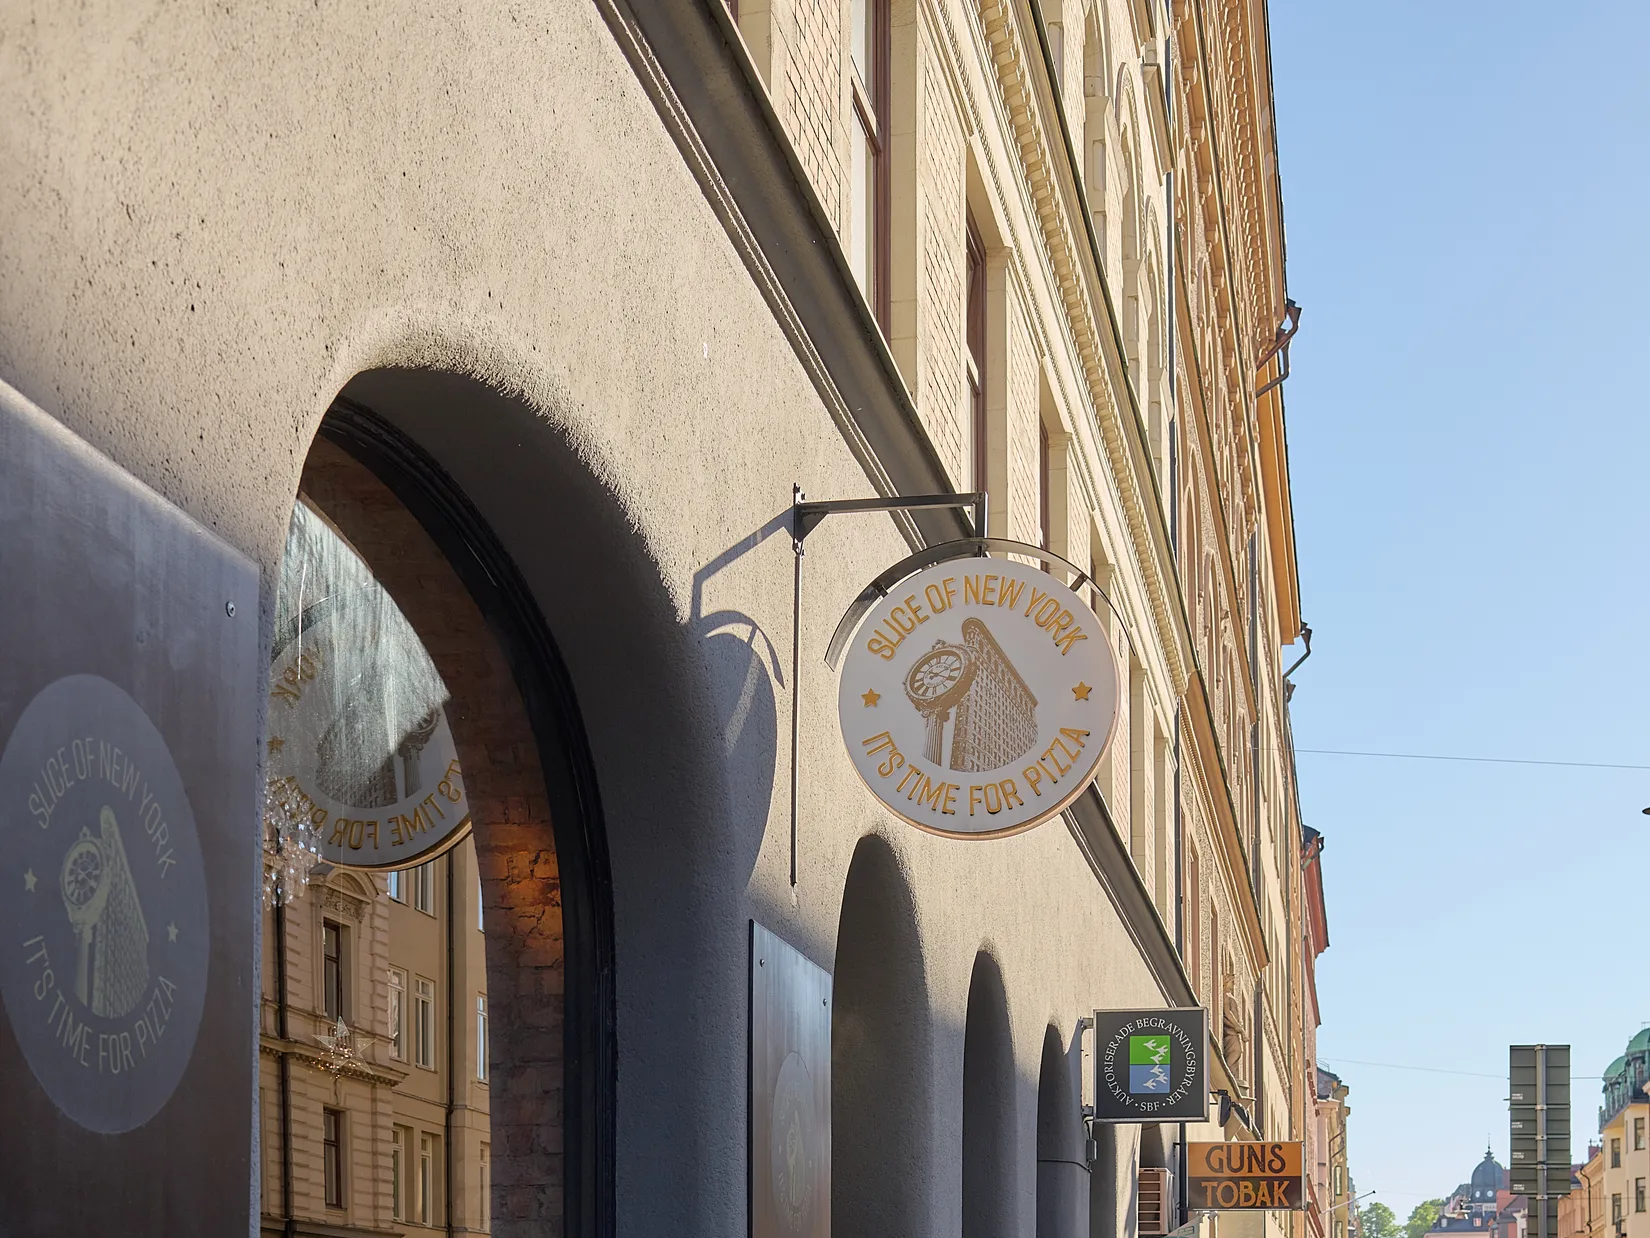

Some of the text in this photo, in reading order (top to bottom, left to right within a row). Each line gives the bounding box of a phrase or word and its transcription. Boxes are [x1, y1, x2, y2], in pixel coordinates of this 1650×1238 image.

[867, 574, 1088, 661] SLICE OF NEW YORK
[28, 738, 177, 879] SLICE OF NEW YORK
[862, 727, 1090, 816] IT'S TIME FOR PIZZA
[23, 935, 177, 1075] IT'S TIME FOR PIZZA
[1104, 1017, 1196, 1105] AUKTORISERADE BEGRAVNINGSBYRÅER
[1139, 1101, 1160, 1111] SBF
[1200, 1180, 1290, 1207] TOBAK
[1204, 1143, 1286, 1173] GUNS
